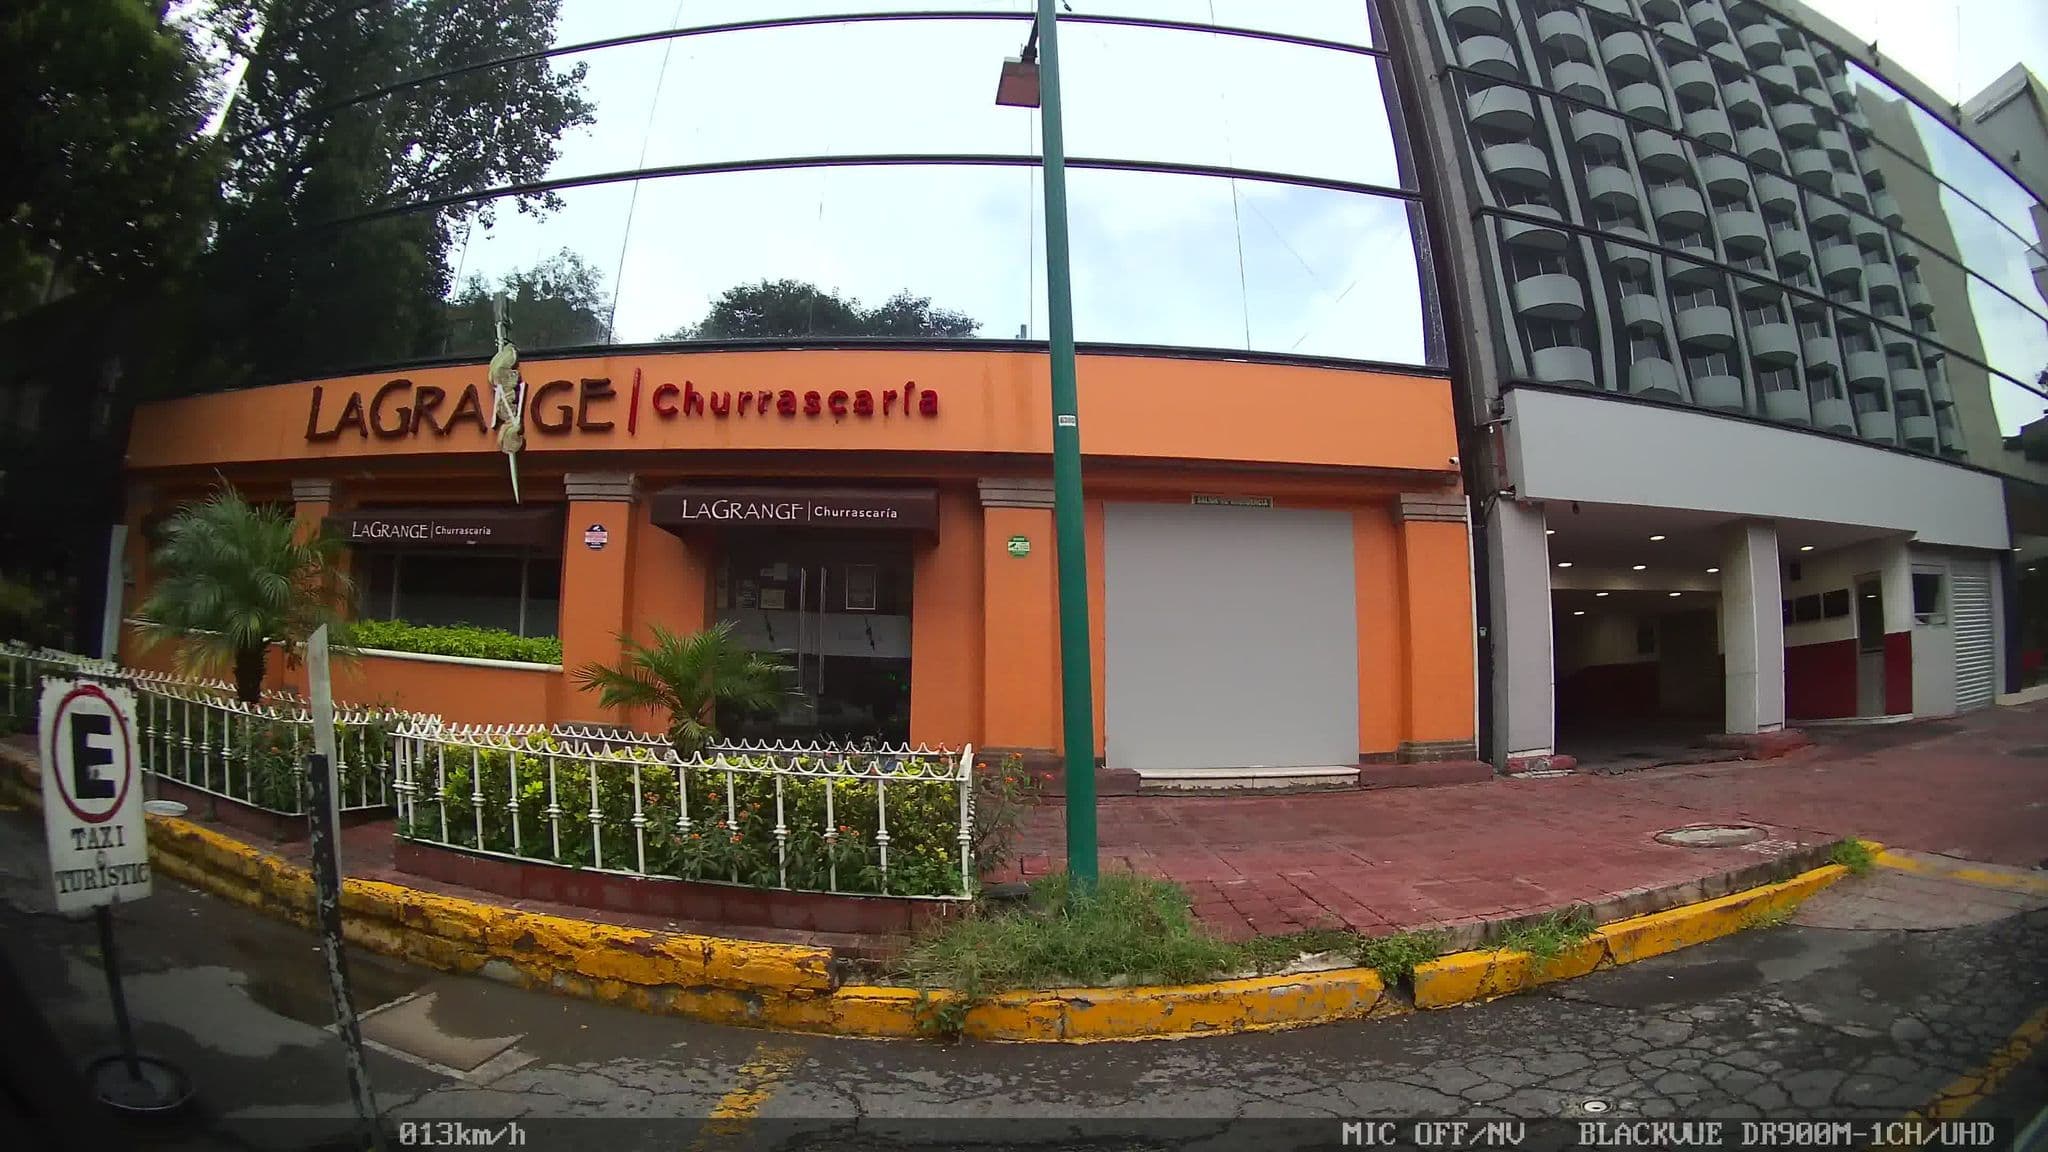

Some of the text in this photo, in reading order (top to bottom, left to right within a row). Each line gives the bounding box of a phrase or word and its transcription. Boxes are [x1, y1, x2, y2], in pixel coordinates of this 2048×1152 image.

[351, 520, 428, 540] LAGRANGE
[71, 713, 115, 799] E
[72, 825, 125, 850] TAXI
